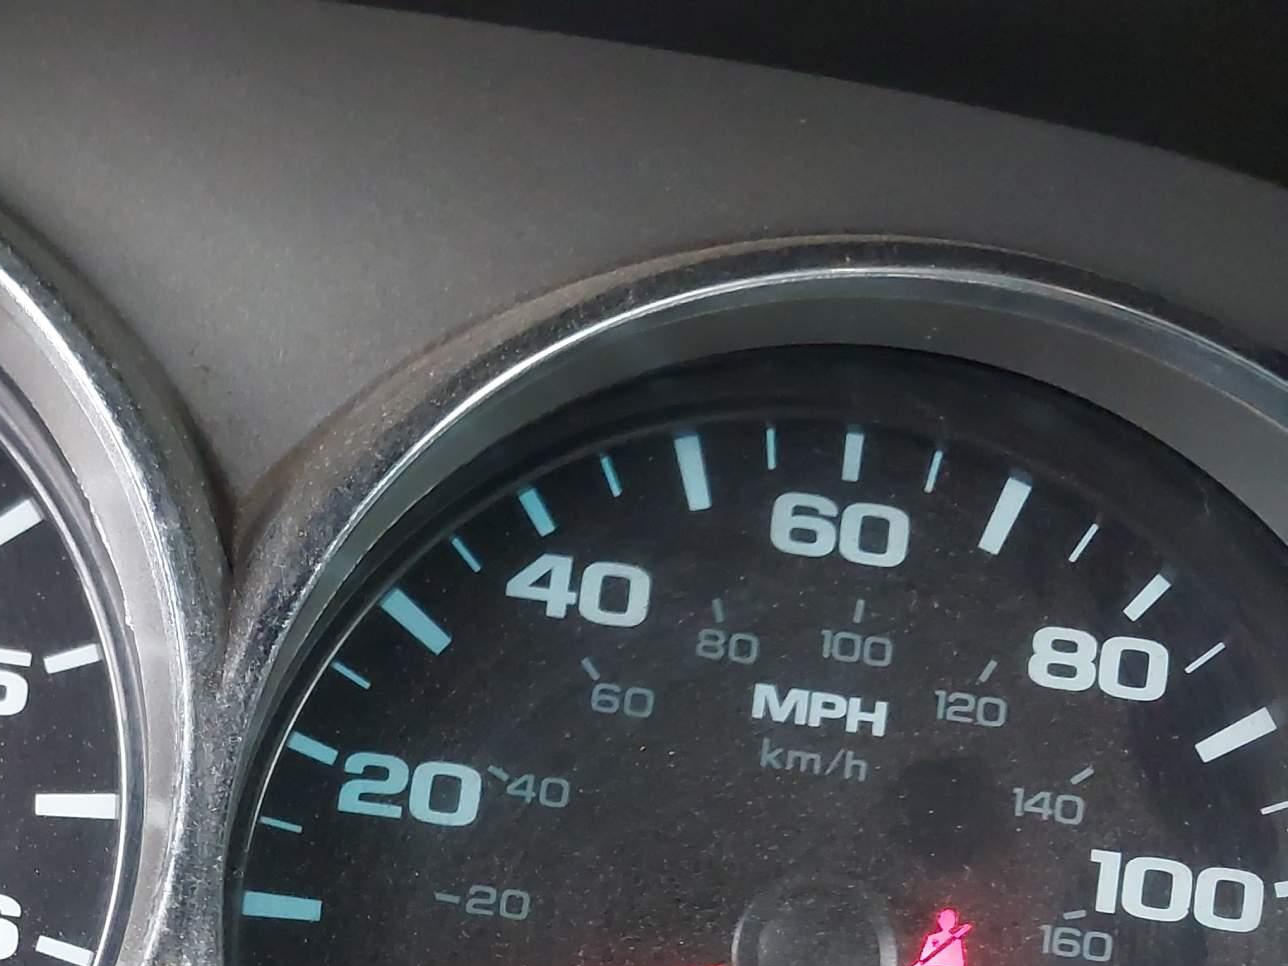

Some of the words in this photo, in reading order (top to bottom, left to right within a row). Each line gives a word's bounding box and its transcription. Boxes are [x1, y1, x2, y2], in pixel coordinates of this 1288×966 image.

[771, 493, 909, 567] 60
[506, 554, 650, 626] 40
[696, 629, 758, 663] 80
[822, 630, 892, 666] 100
[1028, 627, 1168, 701] 80
[592, 683, 653, 717] 60
[752, 684, 887, 736] MPH
[935, 691, 1006, 726] 120
[760, 740, 867, 781] km/h
[337, 754, 481, 826] 20
[507, 775, 569, 807] 40
[1014, 788, 1084, 824] 140
[466, 885, 529, 919] 20
[1090, 850, 1264, 932] 100
[1039, 925, 1112, 961] 160
